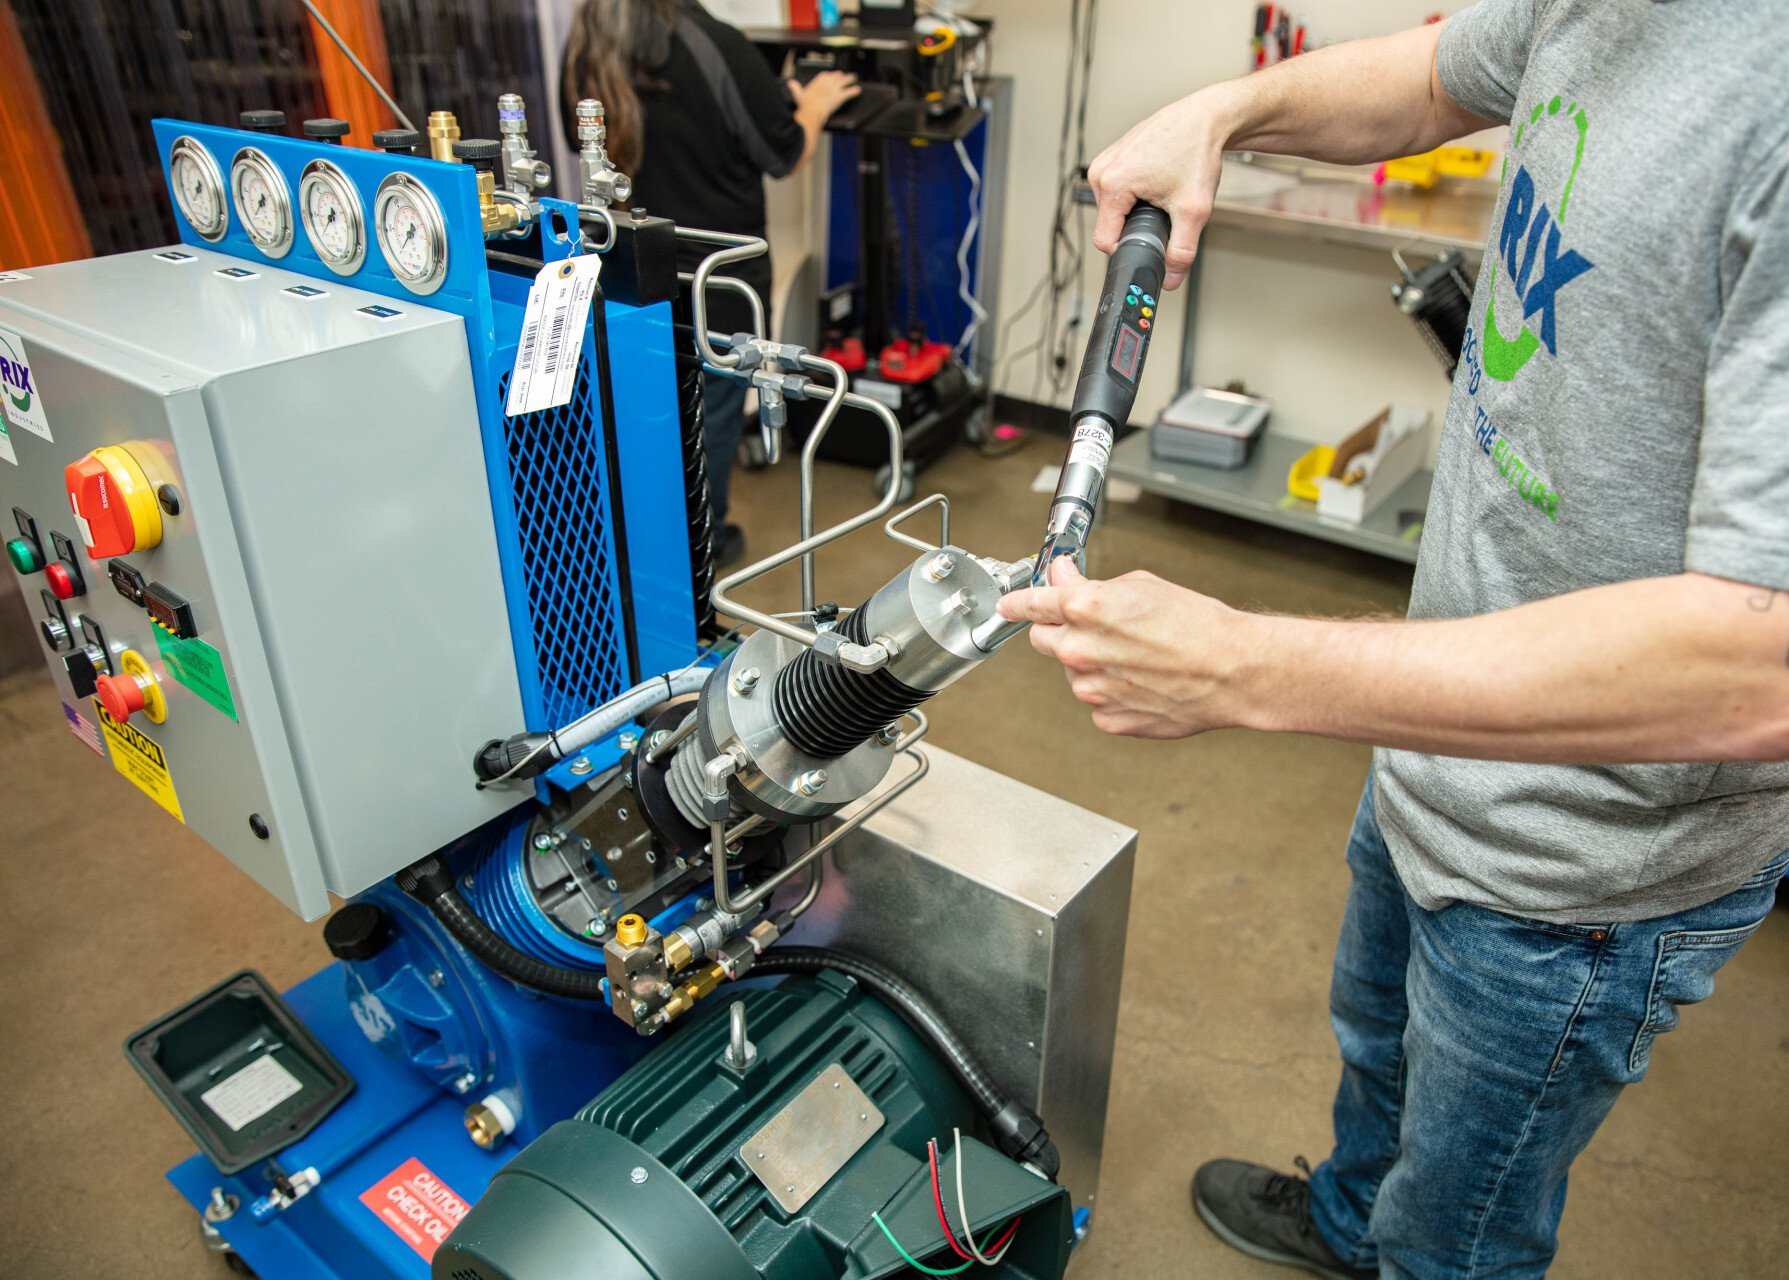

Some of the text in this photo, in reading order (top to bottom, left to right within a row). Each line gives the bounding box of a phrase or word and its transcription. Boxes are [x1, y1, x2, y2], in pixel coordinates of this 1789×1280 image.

[1500, 163, 1596, 357] RIX
[0, 355, 34, 395] RIX
[1474, 405, 1497, 456] THE
[1492, 438, 1561, 523] FUTURE
[386, 1185, 449, 1244] CHECK OIL
[413, 1172, 470, 1221] CAUTION
